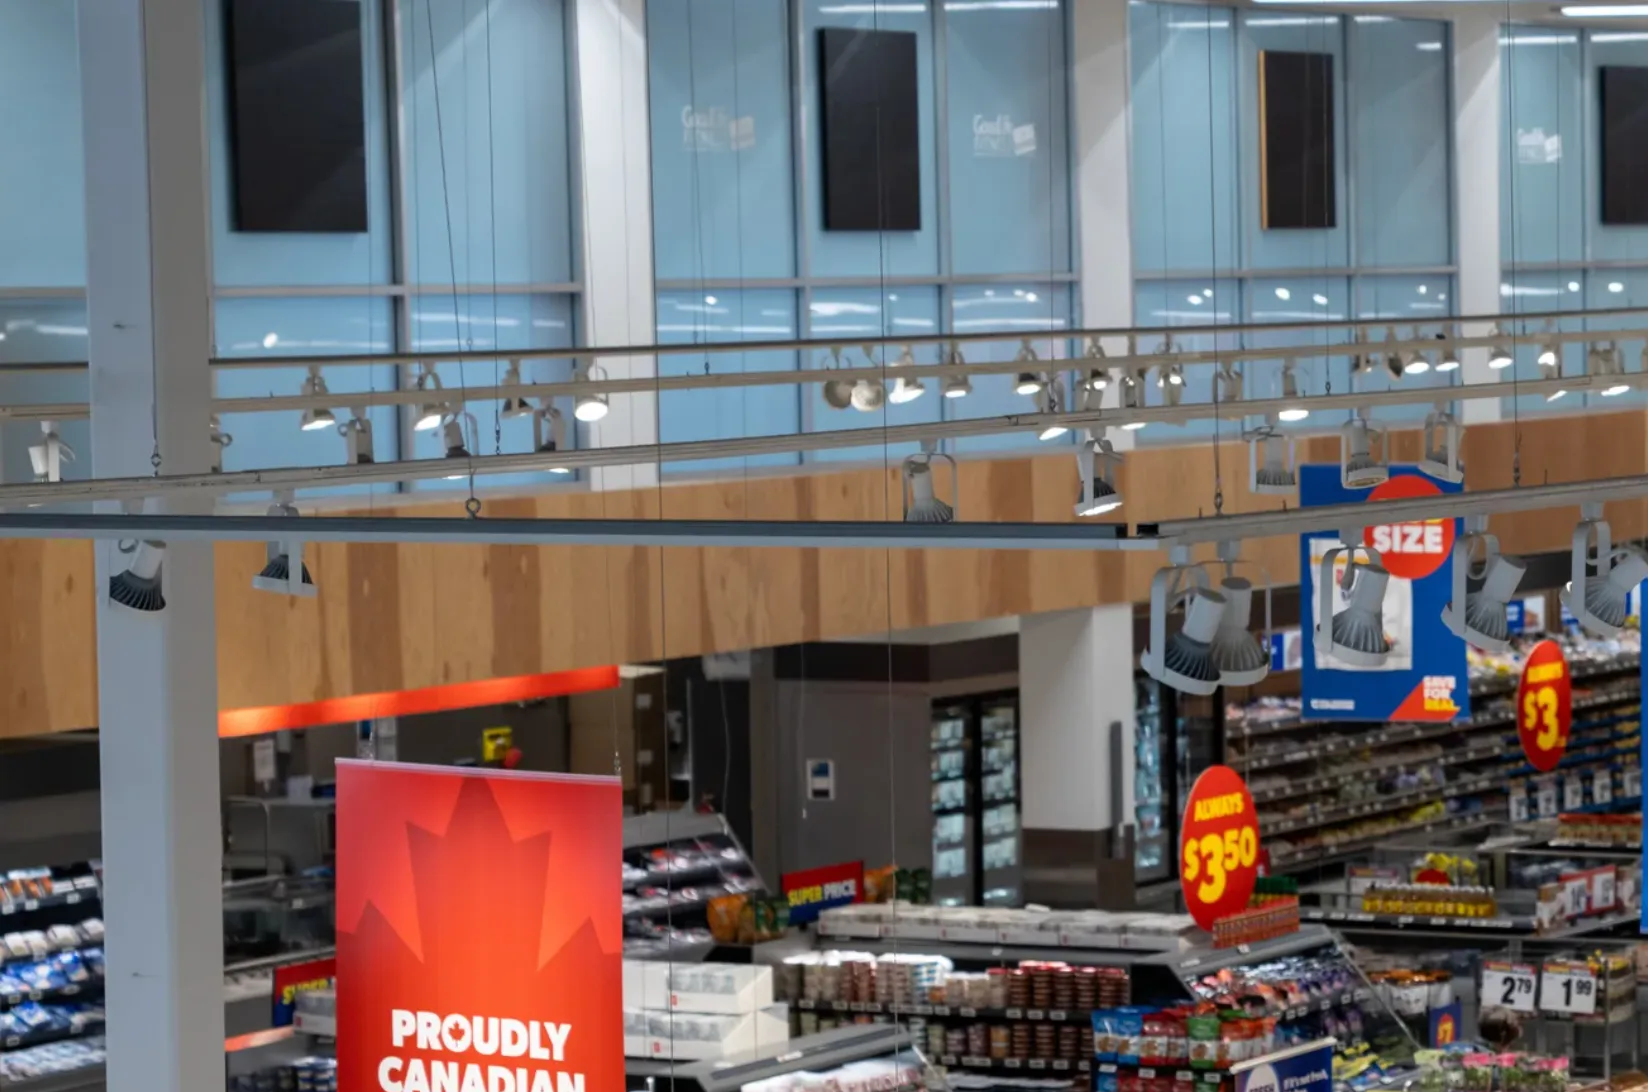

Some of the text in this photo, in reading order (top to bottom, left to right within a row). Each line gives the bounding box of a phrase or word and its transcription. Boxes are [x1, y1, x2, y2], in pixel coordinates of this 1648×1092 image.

[1372, 524, 1444, 554] SIZE
[1193, 791, 1244, 822] ALWAYS
[788, 878, 856, 906] SUPER PRICE
[391, 1008, 572, 1062] PROUDLY
